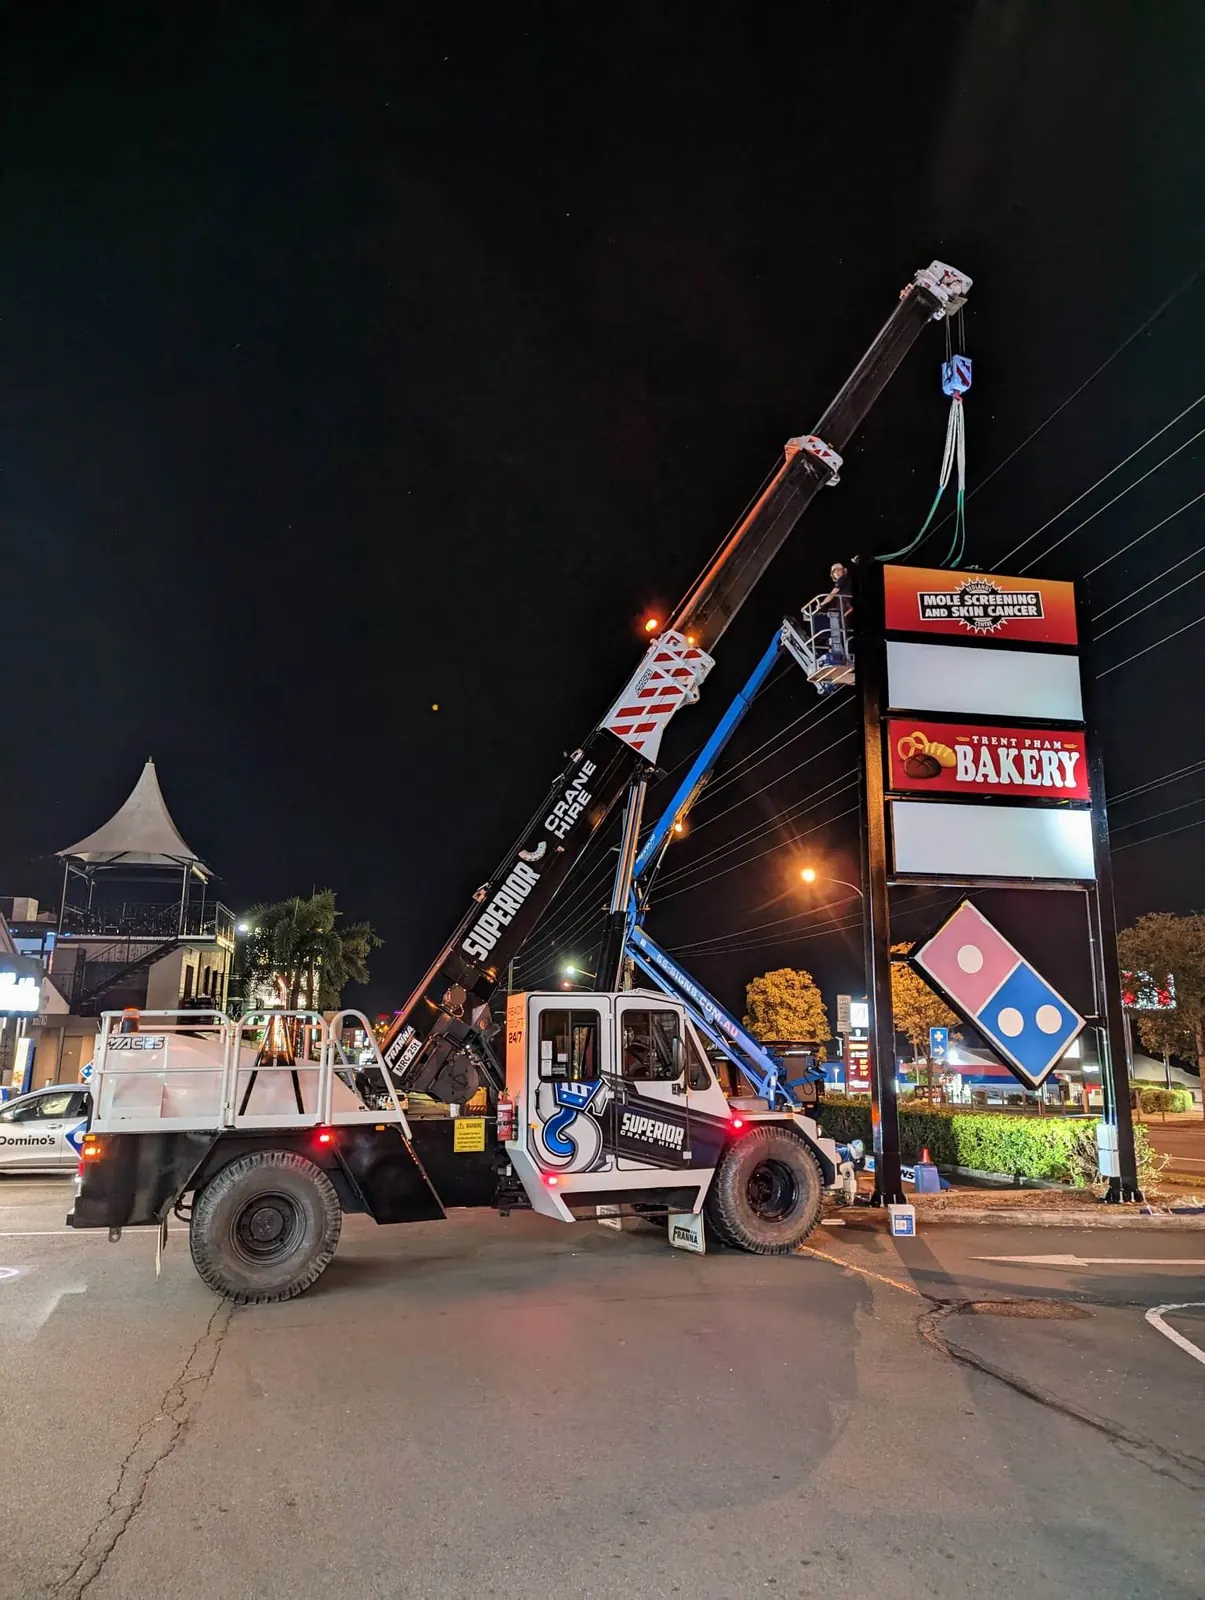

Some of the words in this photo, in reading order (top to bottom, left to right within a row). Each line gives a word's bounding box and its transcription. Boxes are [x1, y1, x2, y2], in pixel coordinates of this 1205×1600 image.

[923, 595, 961, 606] MOLE
[964, 594, 1037, 605] SCREENING
[925, 608, 948, 617] AND
[951, 606, 984, 617] SKIN
[987, 605, 1038, 616] CANCER
[972, 735, 1017, 747] TRENT
[1025, 739, 1062, 749] PHAM
[954, 744, 1080, 789] BAKERY
[544, 760, 597, 832] CRANE
[554, 789, 592, 840] HIRE
[461, 861, 541, 962] SUPERIOR
[384, 1025, 416, 1069] FRANNA
[508, 1031, 523, 1044] 24/7
[396, 1055, 411, 1073] MRC
[408, 1042, 420, 1056] 25t
[0, 1134, 56, 1146] Domino's
[620, 1129, 654, 1144] CRANE
[658, 1140, 682, 1151] HIRE
[621, 1112, 685, 1146] SUPERIOR
[672, 1225, 698, 1244] FRANNA
